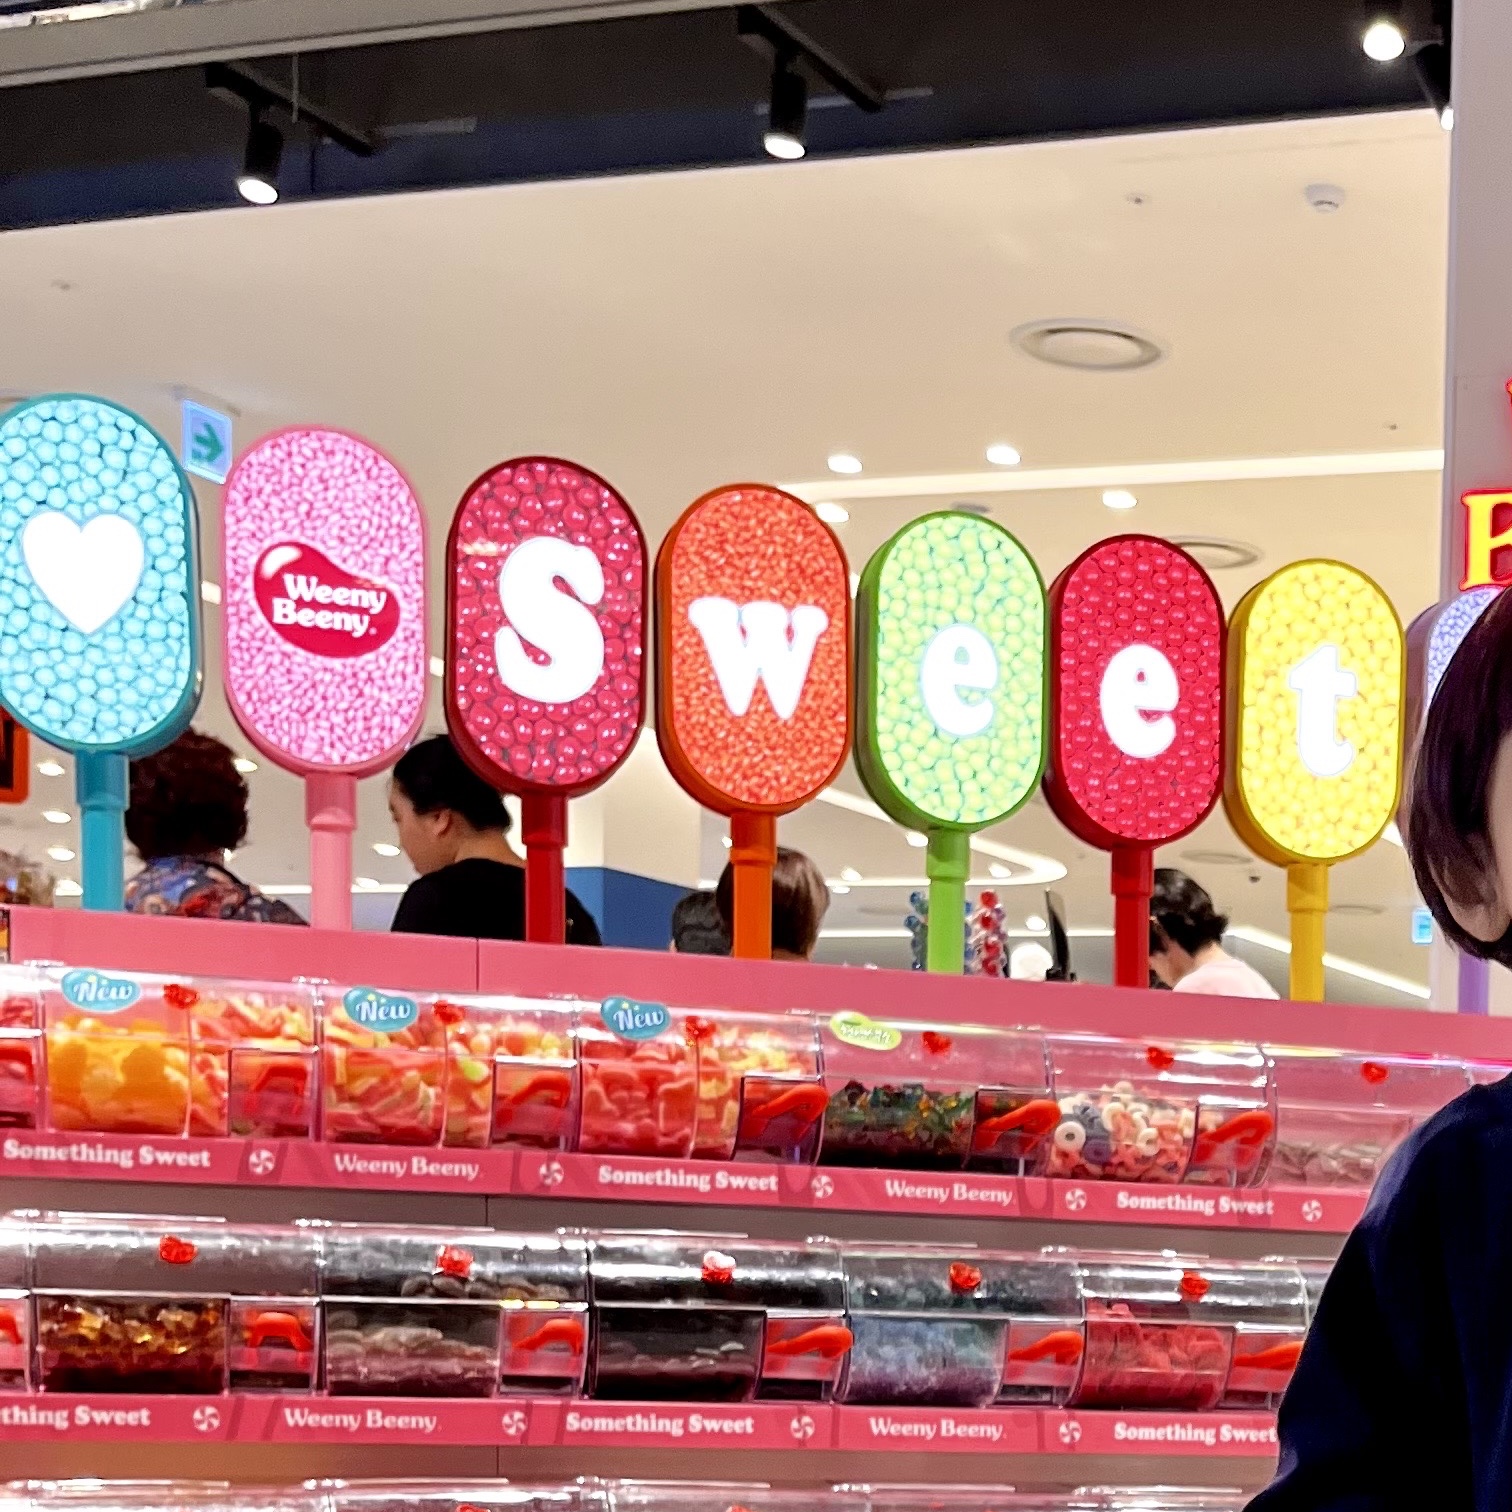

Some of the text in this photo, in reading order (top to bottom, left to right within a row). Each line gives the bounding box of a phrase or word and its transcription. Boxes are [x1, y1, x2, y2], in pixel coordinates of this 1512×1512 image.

[284, 573, 387, 614] Weeny
[73, 980, 133, 1002] New
[356, 1000, 411, 1022] New
[613, 1009, 664, 1031] New
[4, 1138, 210, 1168] Something Sweet
[334, 1153, 407, 1178] Weeny
[599, 1164, 778, 1193] Something Sweet
[885, 1178, 950, 1203] Weeny
[1117, 1190, 1274, 1217] Something Sweet
[74, 1404, 151, 1427] Sweet
[284, 1407, 361, 1432] Weeny
[566, 1411, 754, 1437] Something Sweet
[869, 1416, 937, 1441] Weeny
[1115, 1421, 1277, 1446] Something Sweet
